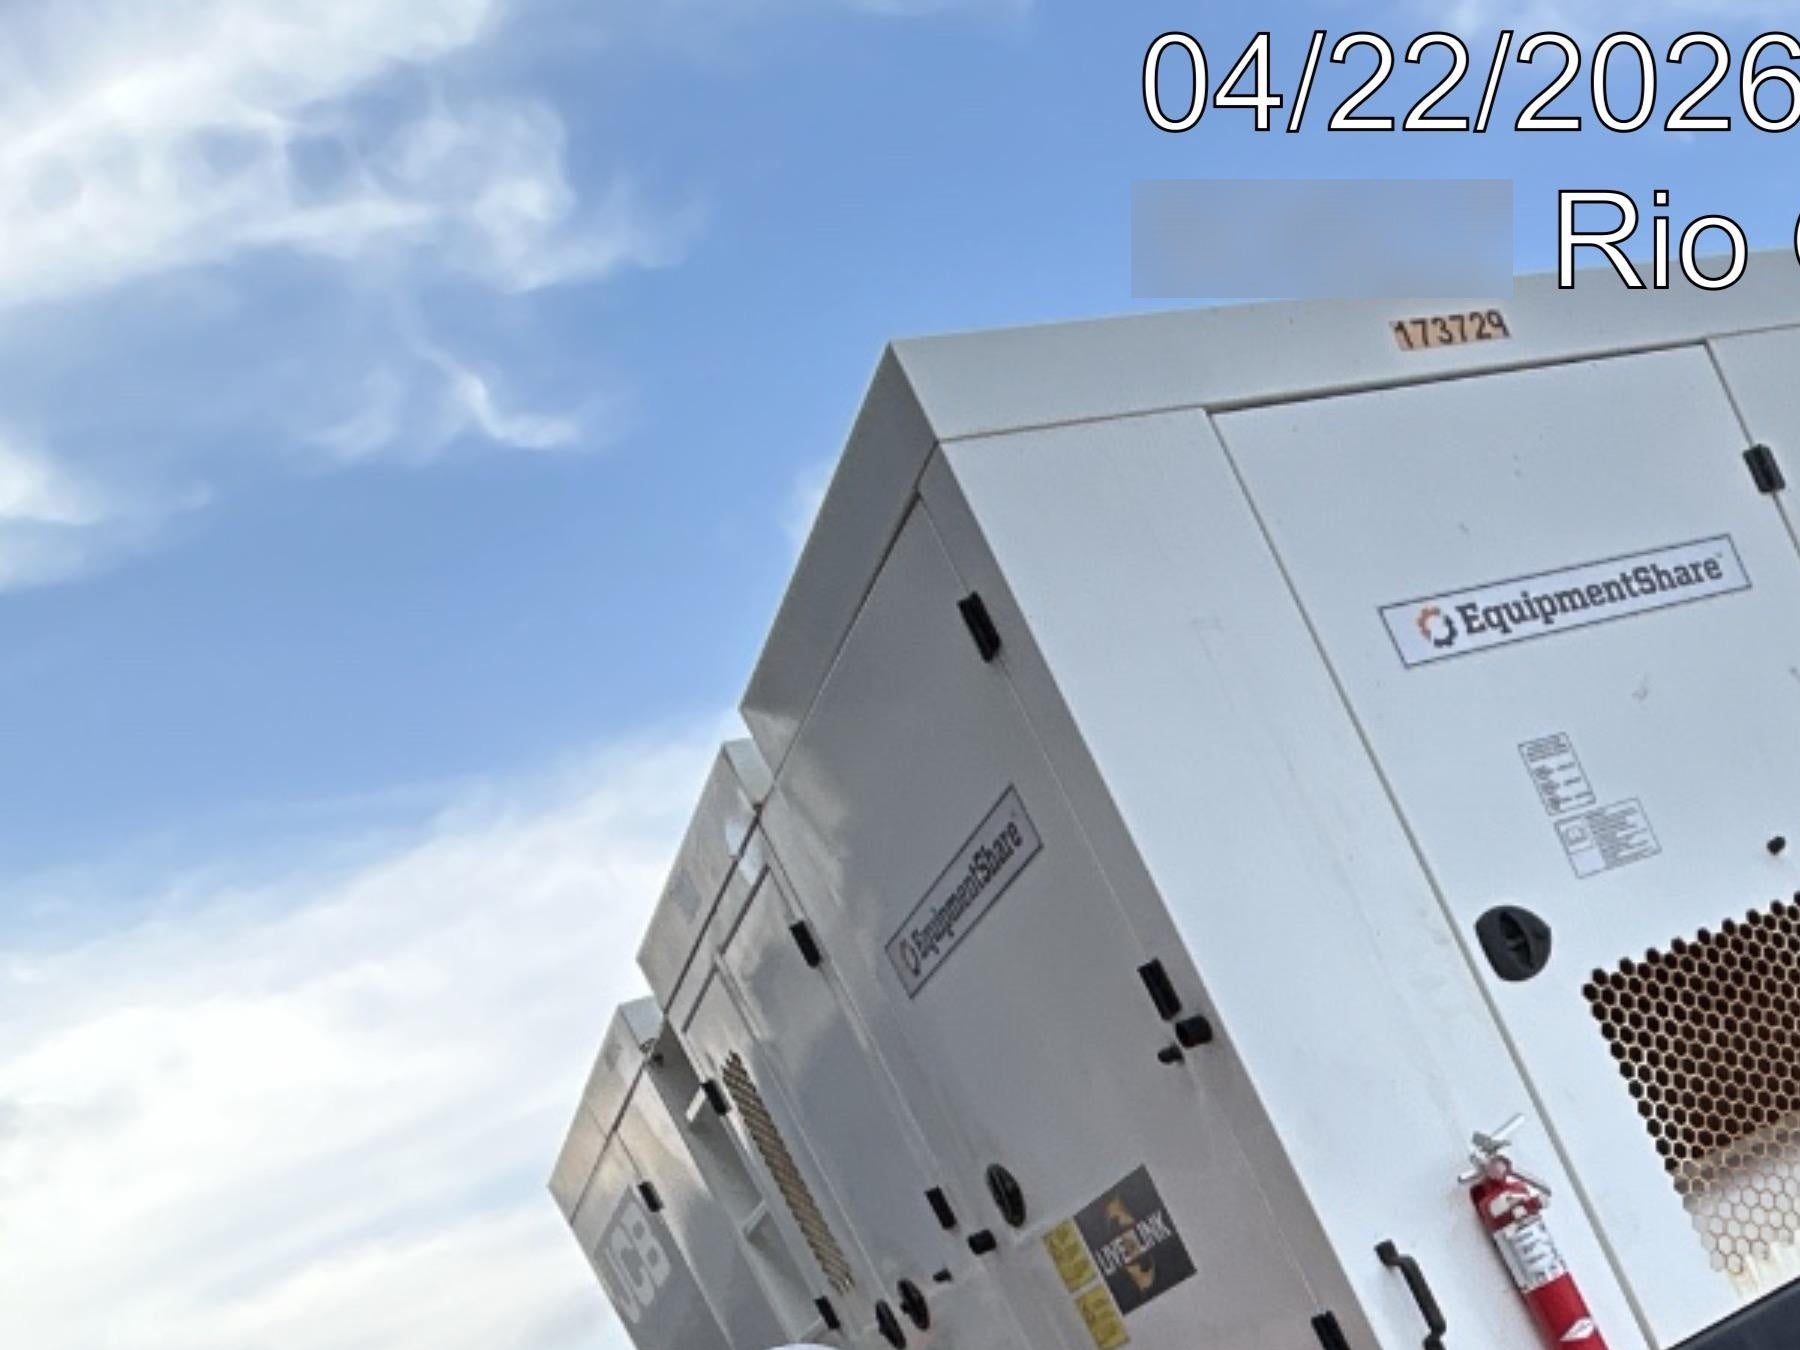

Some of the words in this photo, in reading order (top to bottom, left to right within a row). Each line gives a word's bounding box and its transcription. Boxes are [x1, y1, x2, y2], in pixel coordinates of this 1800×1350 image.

[1394, 308, 1511, 349] 173729
[1455, 556, 1723, 635] EquipmentShare
[910, 820, 1024, 960] EquipmentShare
